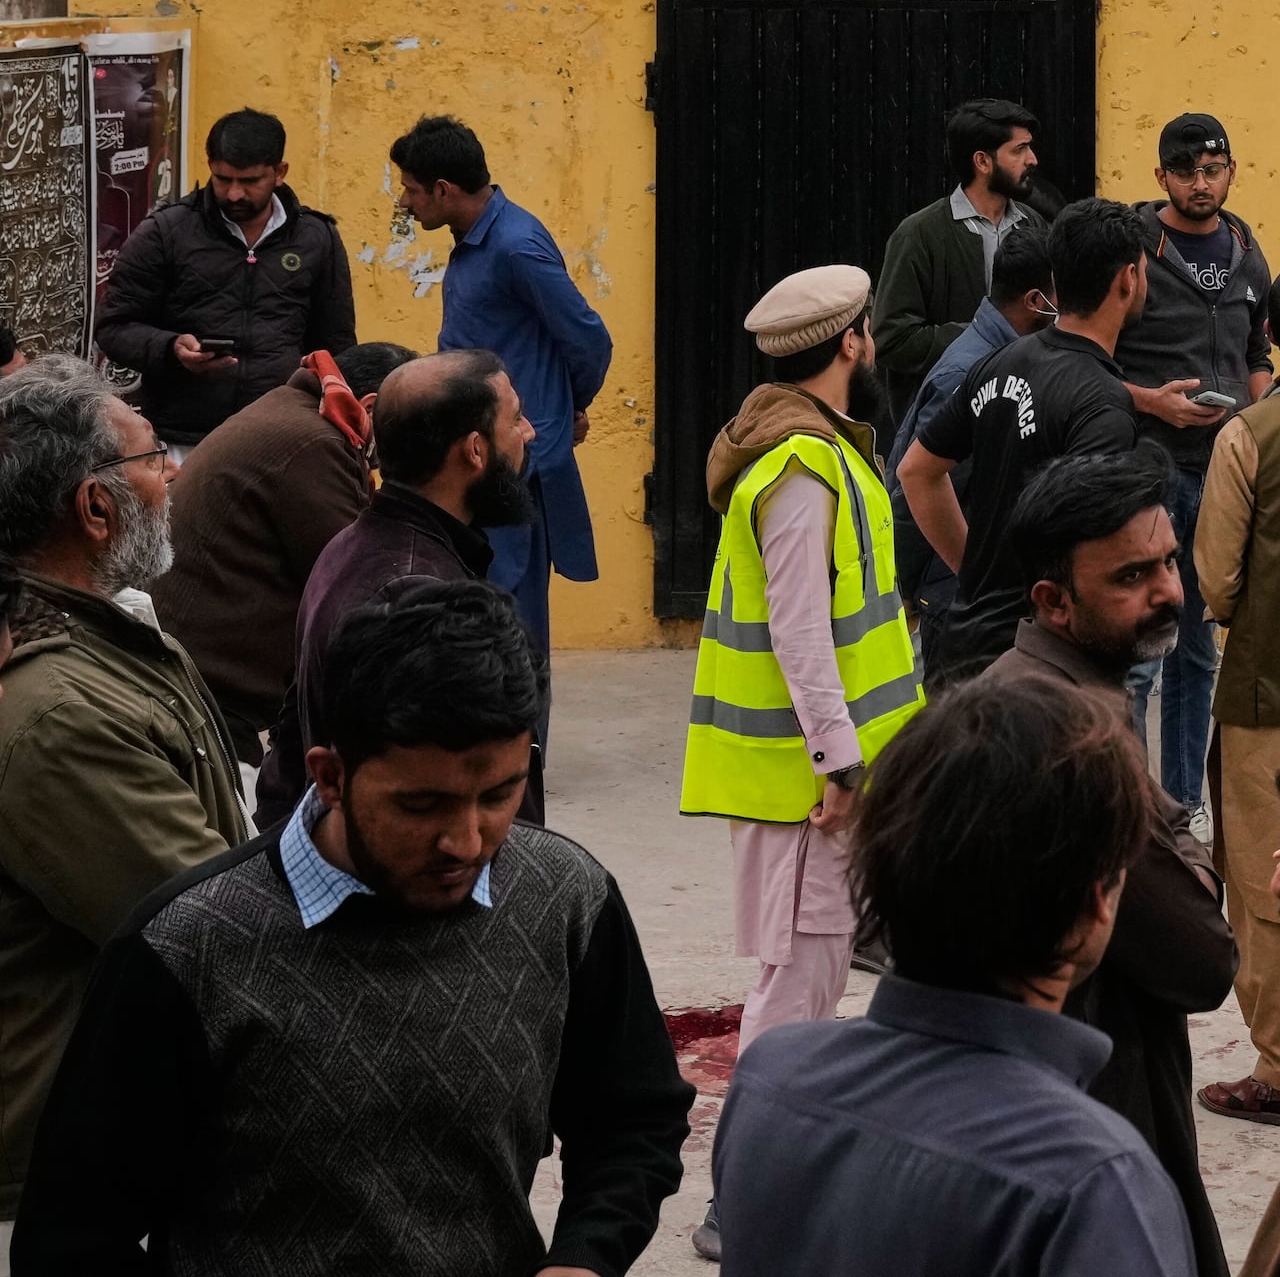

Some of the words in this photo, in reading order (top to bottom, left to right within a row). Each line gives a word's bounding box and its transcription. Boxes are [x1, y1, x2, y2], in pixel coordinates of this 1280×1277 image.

[62, 56, 79, 91] 15
[95, 109, 125, 120] بسلسل
[114, 162, 132, 171] 2:00
[969, 376, 998, 418] CIVIL
